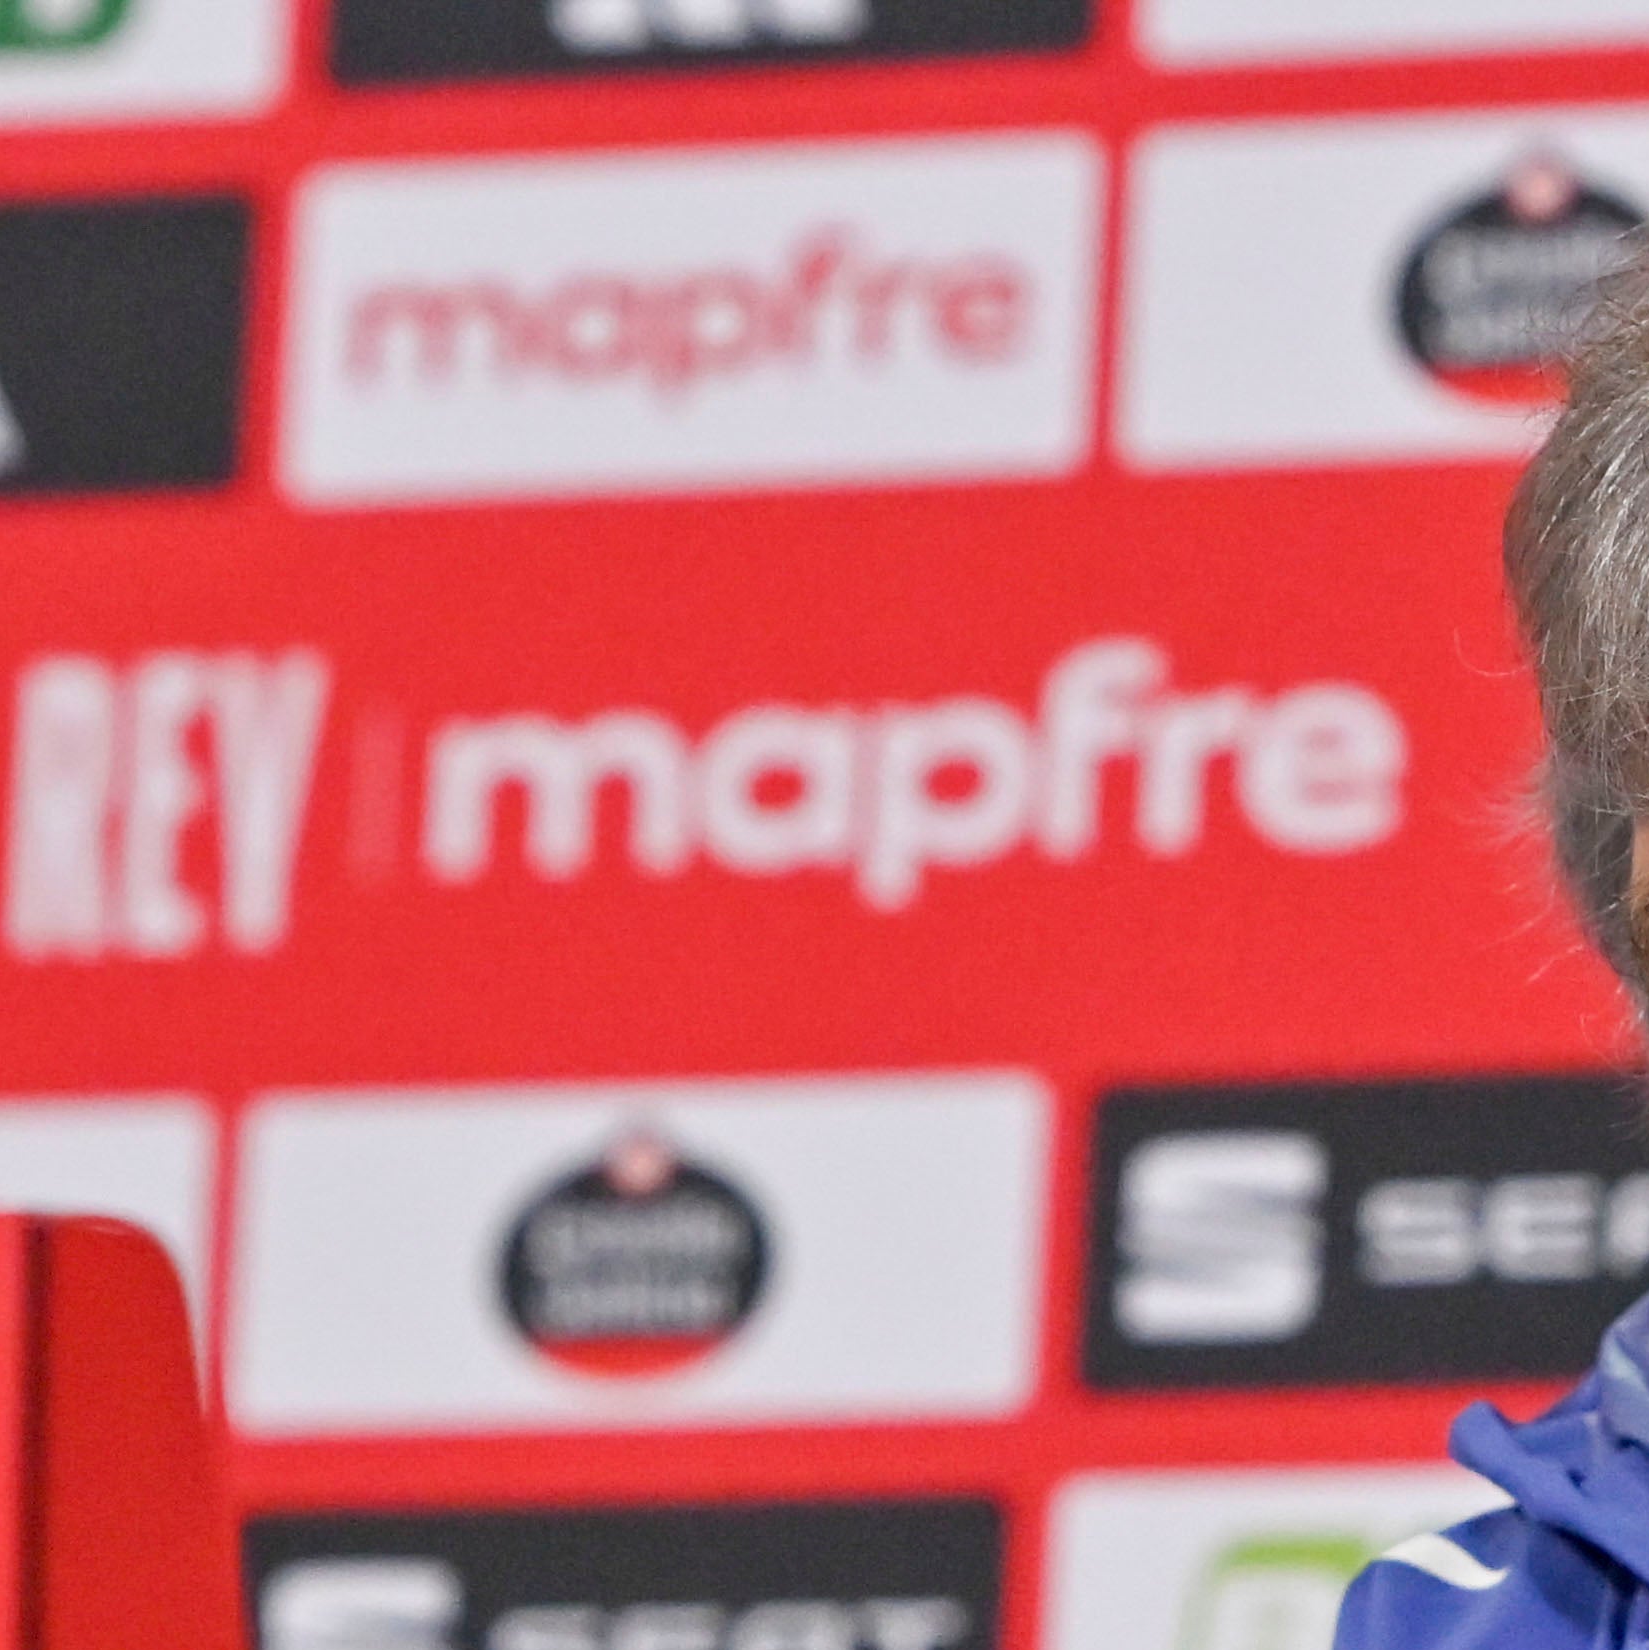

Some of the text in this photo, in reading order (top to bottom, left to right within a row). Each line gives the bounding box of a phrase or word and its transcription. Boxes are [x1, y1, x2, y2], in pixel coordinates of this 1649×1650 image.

[345, 222, 1030, 410] mapfre
[2, 642, 331, 963] REY
[418, 636, 1407, 908] mapfre
